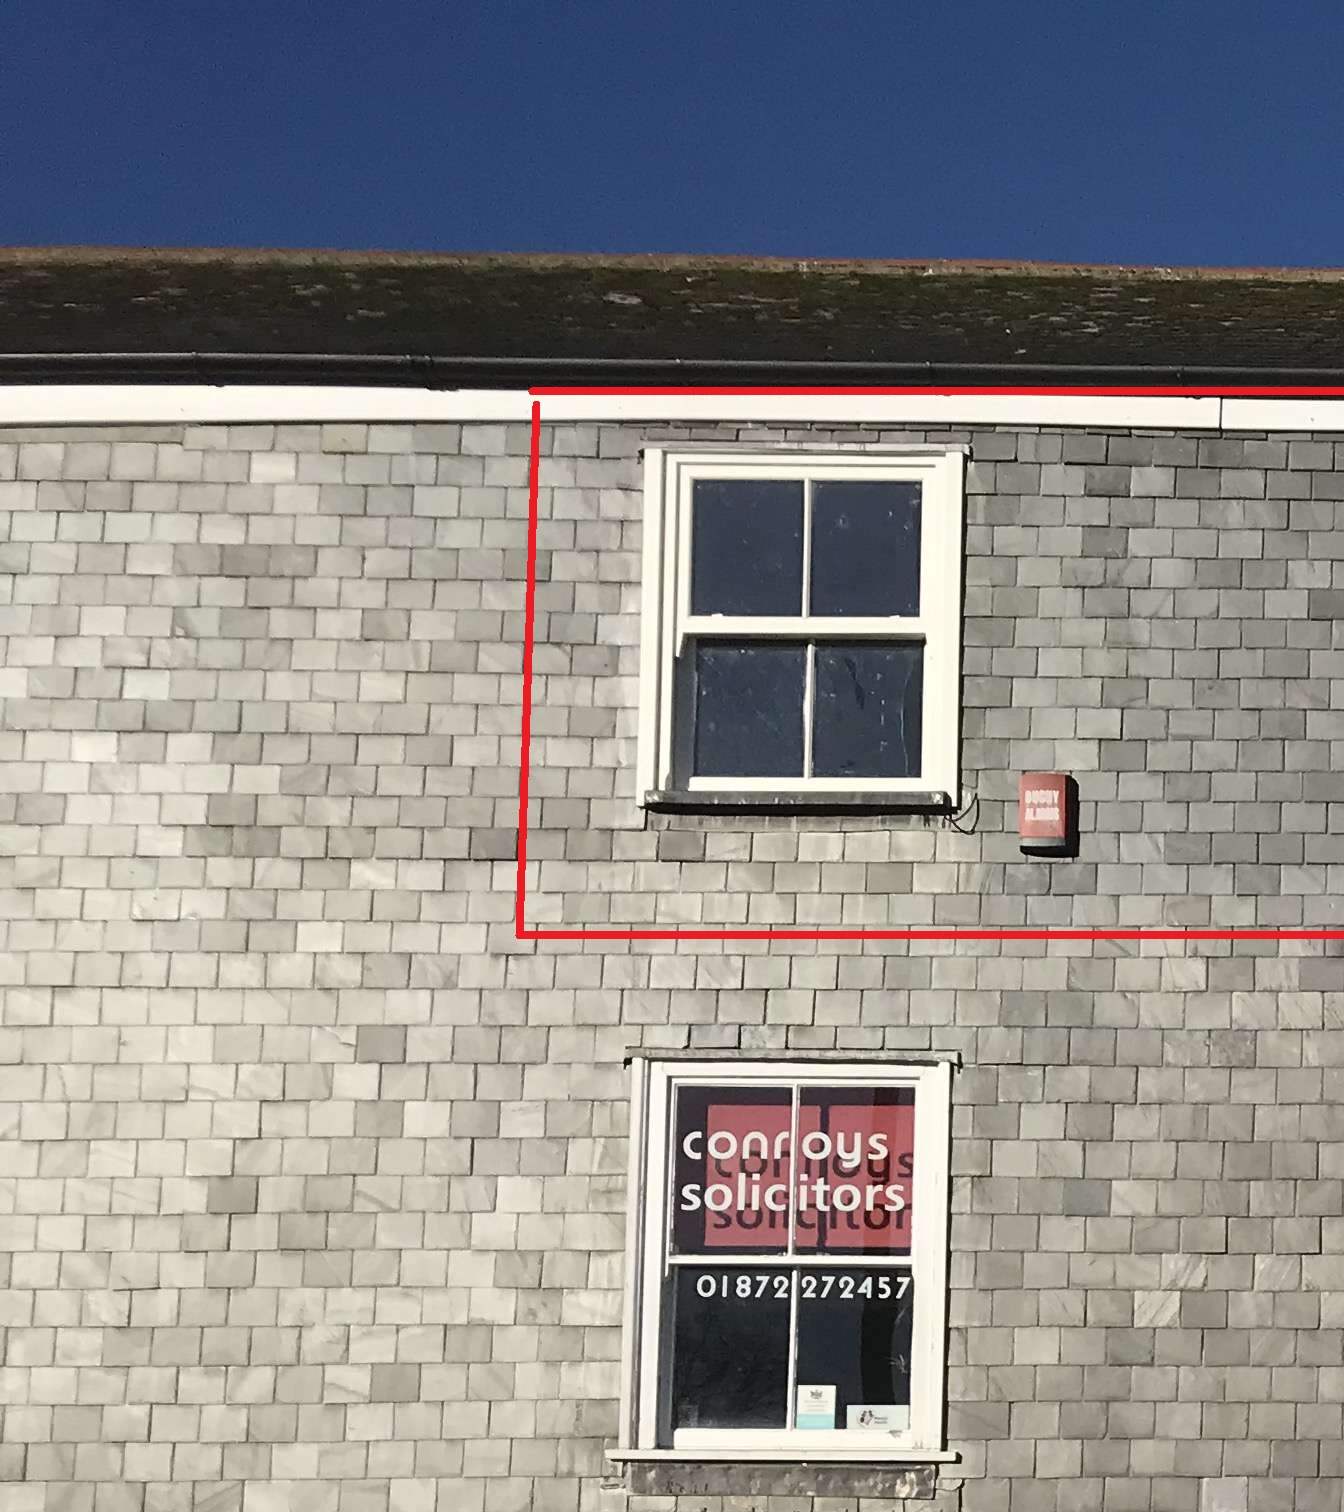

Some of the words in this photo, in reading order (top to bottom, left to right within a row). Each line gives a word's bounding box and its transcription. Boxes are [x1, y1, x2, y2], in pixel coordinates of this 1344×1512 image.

[682, 1130, 889, 1168] conroys
[680, 1172, 906, 1212] solicitors
[696, 1275, 789, 1299] 01872
[801, 1275, 911, 1299] 272457
